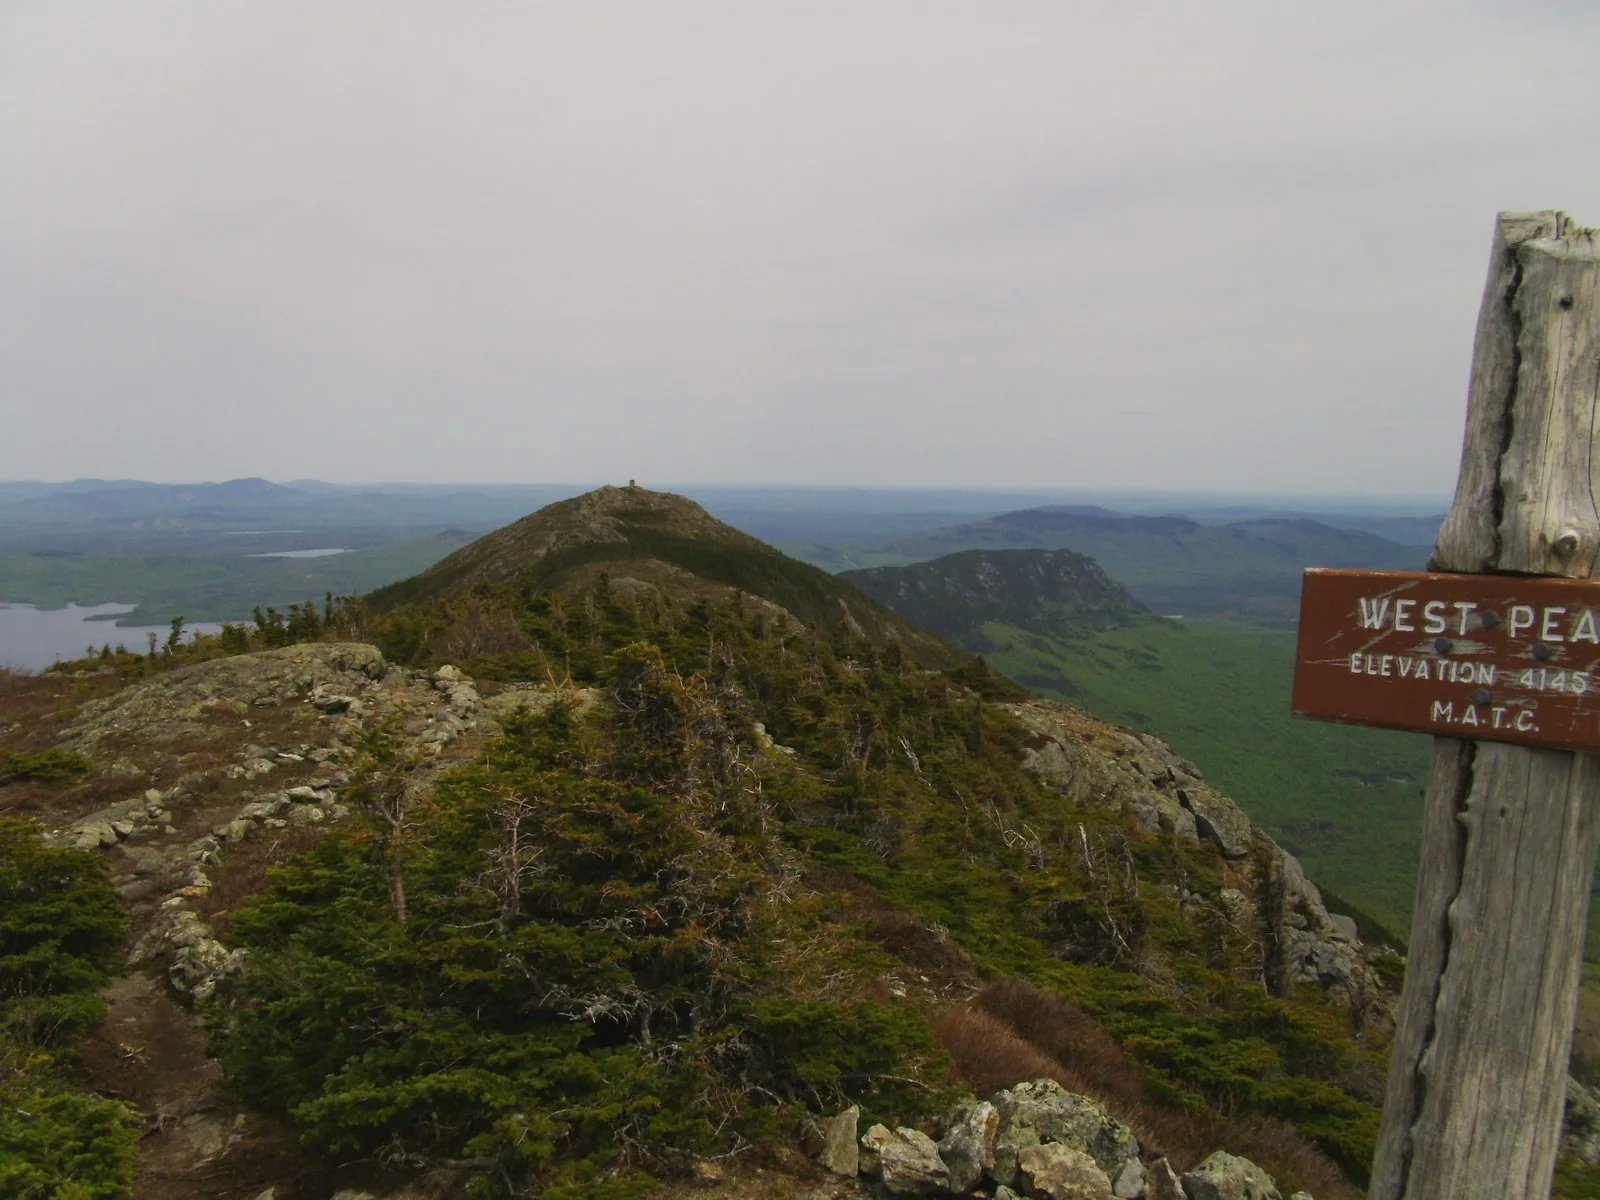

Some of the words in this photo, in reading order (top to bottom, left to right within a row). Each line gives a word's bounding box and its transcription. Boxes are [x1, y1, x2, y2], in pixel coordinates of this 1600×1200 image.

[1359, 597, 1477, 636] WEST
[1509, 605, 1600, 644] PEA
[1350, 652, 1496, 685] ELEVATION
[1519, 668, 1589, 694] 4145
[1431, 700, 1540, 732] M.A.T.C.
